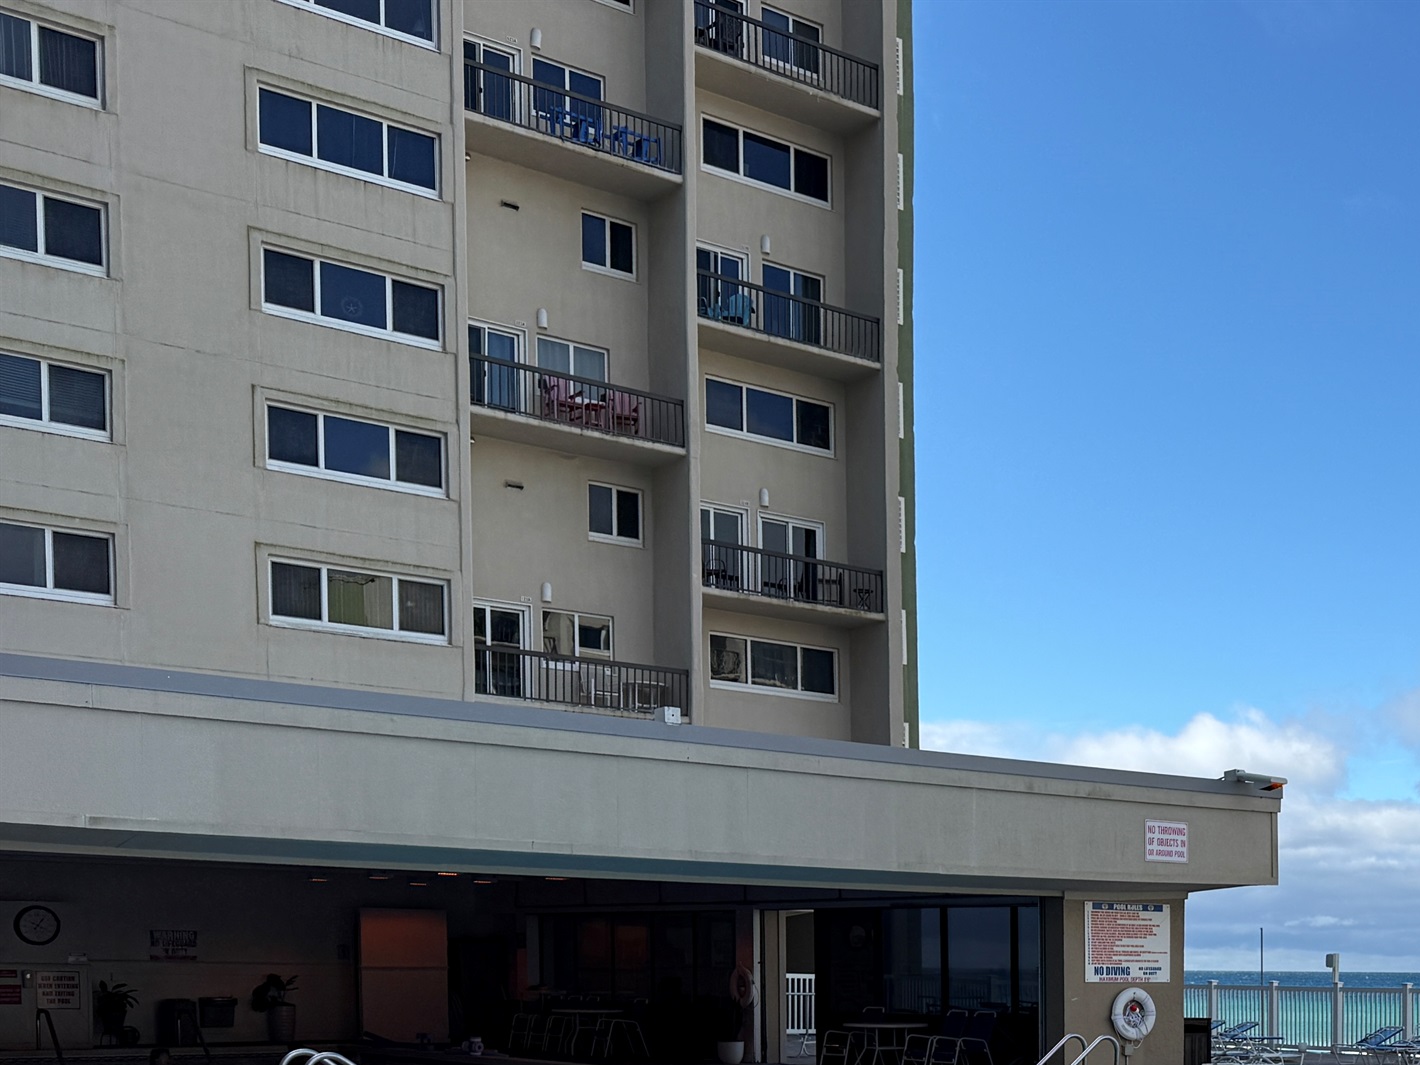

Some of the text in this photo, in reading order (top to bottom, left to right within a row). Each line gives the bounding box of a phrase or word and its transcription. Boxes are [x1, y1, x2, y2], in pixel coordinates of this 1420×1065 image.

[1147, 825, 1186, 836] NO THROWING
[1147, 837, 1186, 848] OF OBJECTS IN
[1147, 848, 1186, 859] OR AROUND POOL
[1093, 966, 1131, 976] NO DIVING
